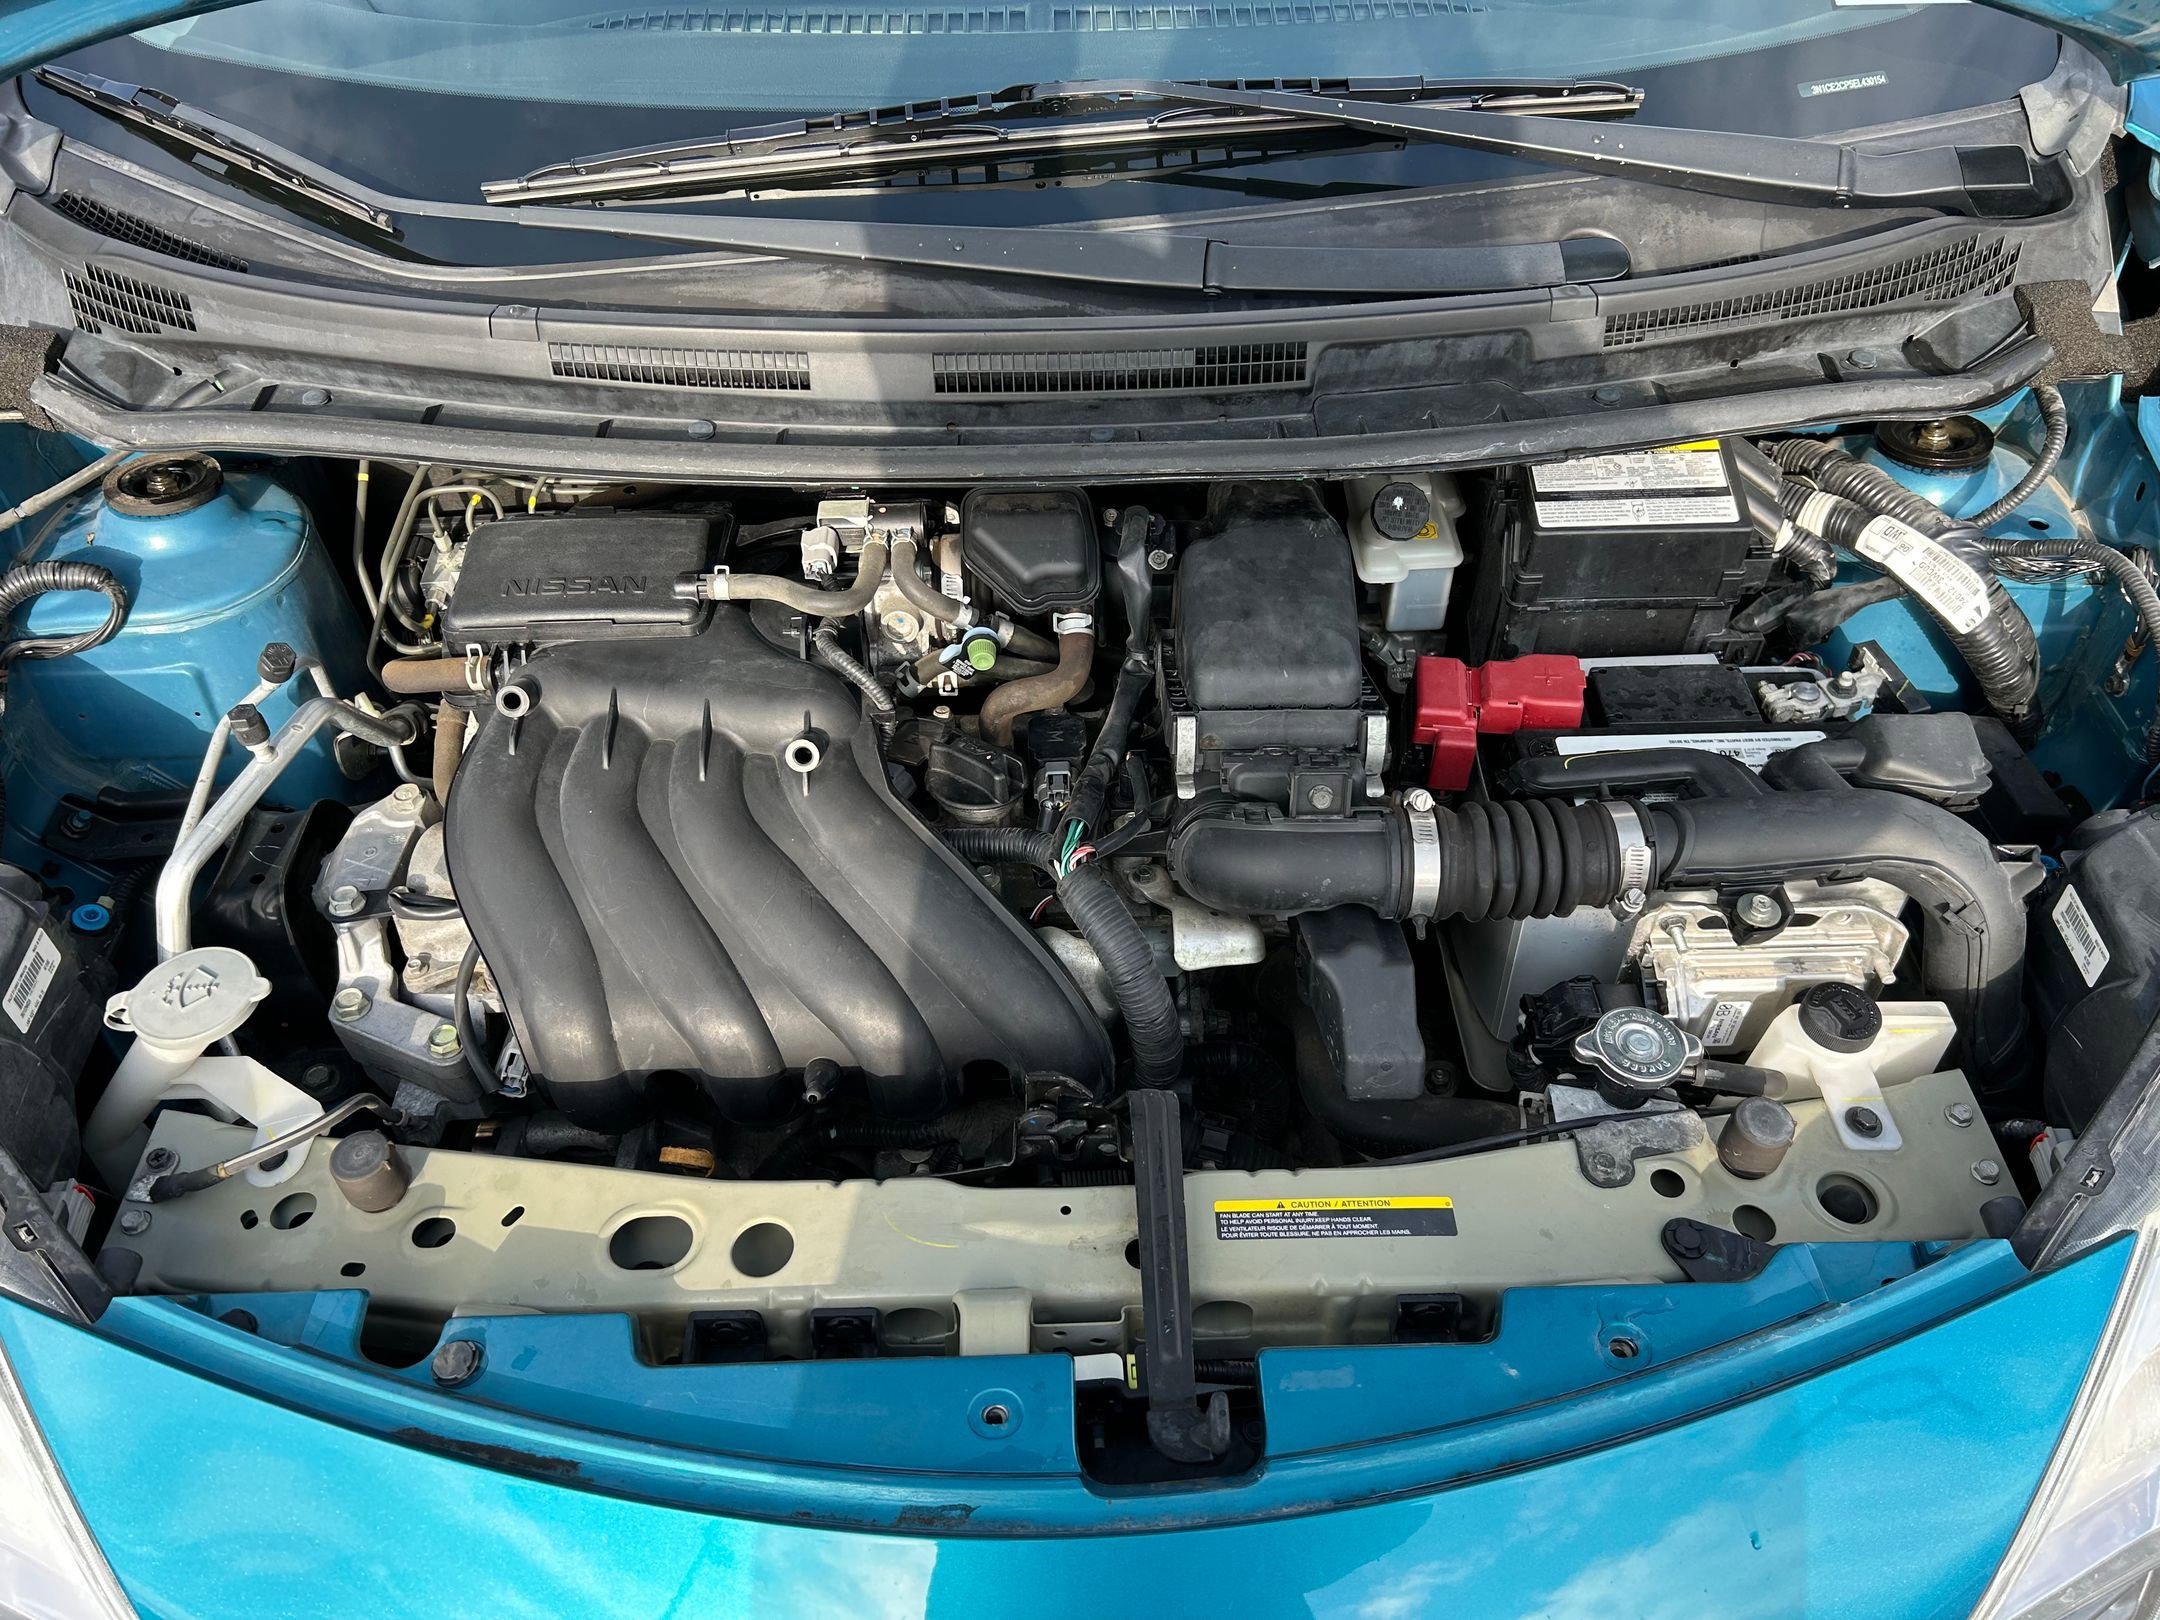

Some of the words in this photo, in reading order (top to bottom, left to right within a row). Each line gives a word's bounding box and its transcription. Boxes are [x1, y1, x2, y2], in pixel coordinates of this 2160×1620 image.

[500, 575, 647, 597] NISSAN
[1290, 1200, 1330, 1208] CAUTION
[1341, 1200, 1391, 1208] ATTENTION
